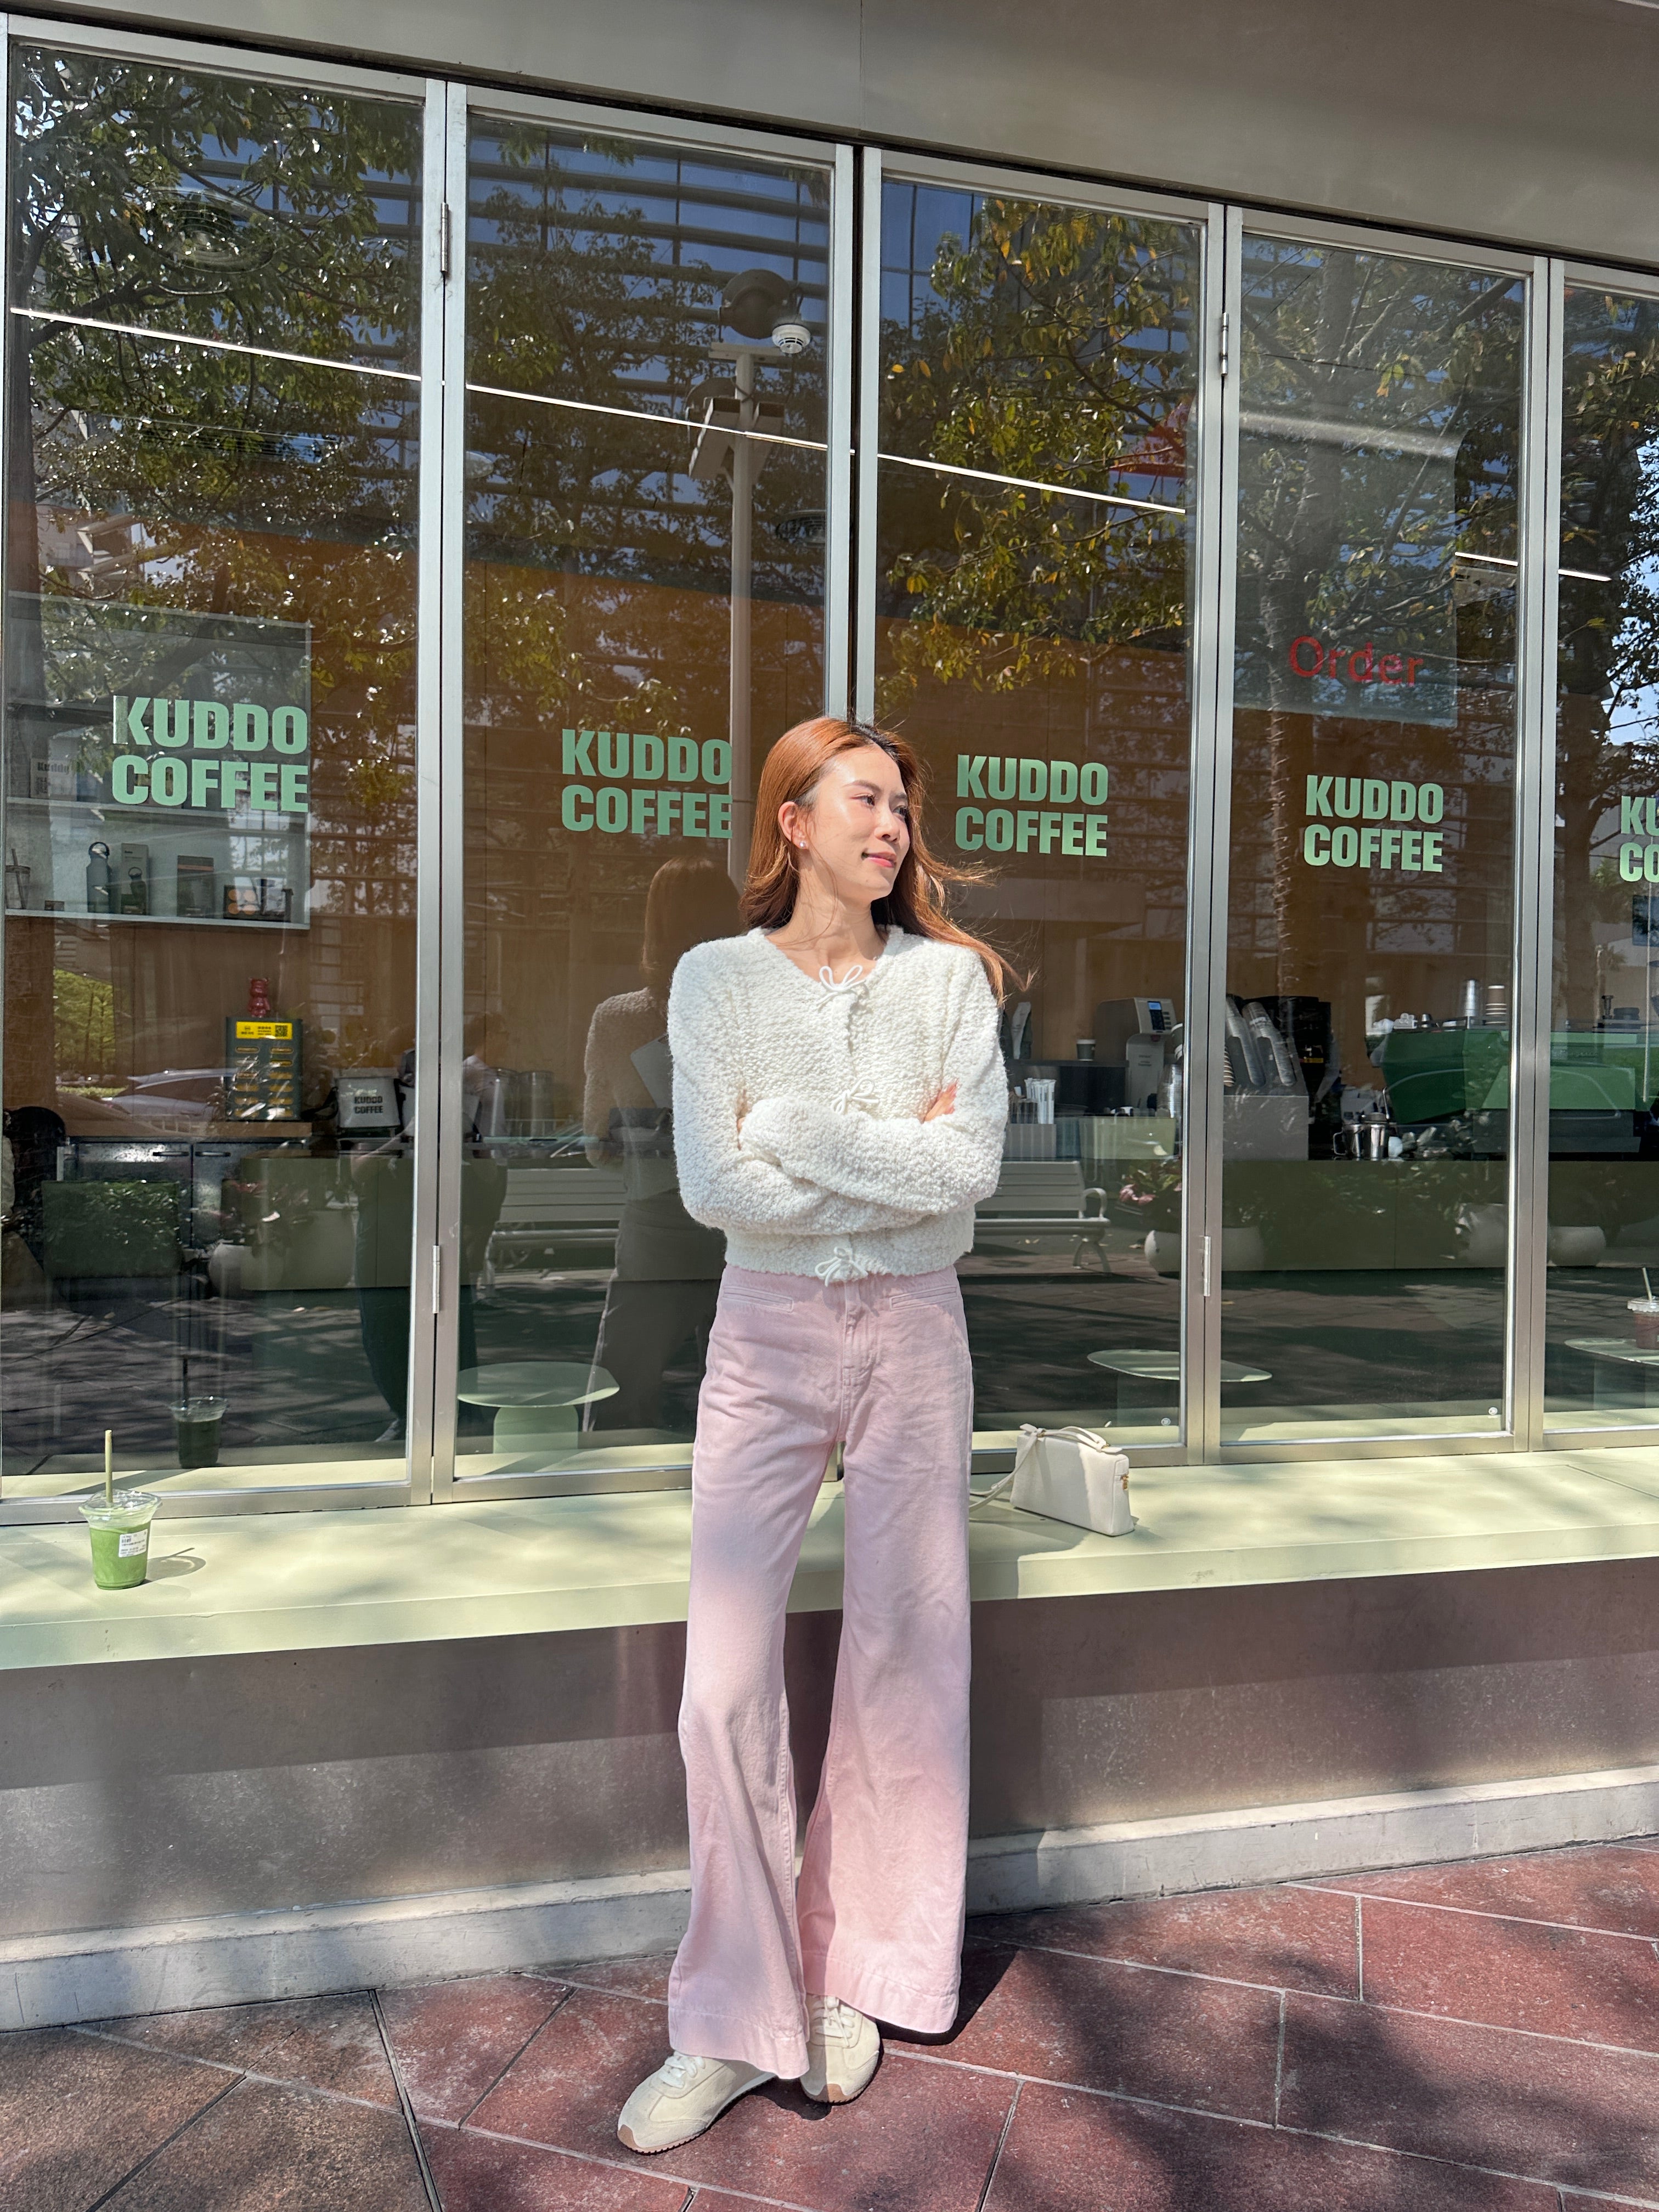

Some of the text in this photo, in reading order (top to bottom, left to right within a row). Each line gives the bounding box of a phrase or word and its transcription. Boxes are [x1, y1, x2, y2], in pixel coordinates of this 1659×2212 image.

[1289, 635, 1424, 686] Order
[112, 695, 307, 754] KUDDO
[562, 729, 732, 784] KUDDO
[957, 754, 1109, 805] KUDDO
[112, 755, 308, 812] COFFEE
[1306, 775, 1444, 823] KUDDO
[561, 785, 732, 839] COFFEE
[955, 806, 1108, 857] COFFEE
[1304, 825, 1443, 872] COFFEE
[354, 1105, 383, 1114] COFFEE
